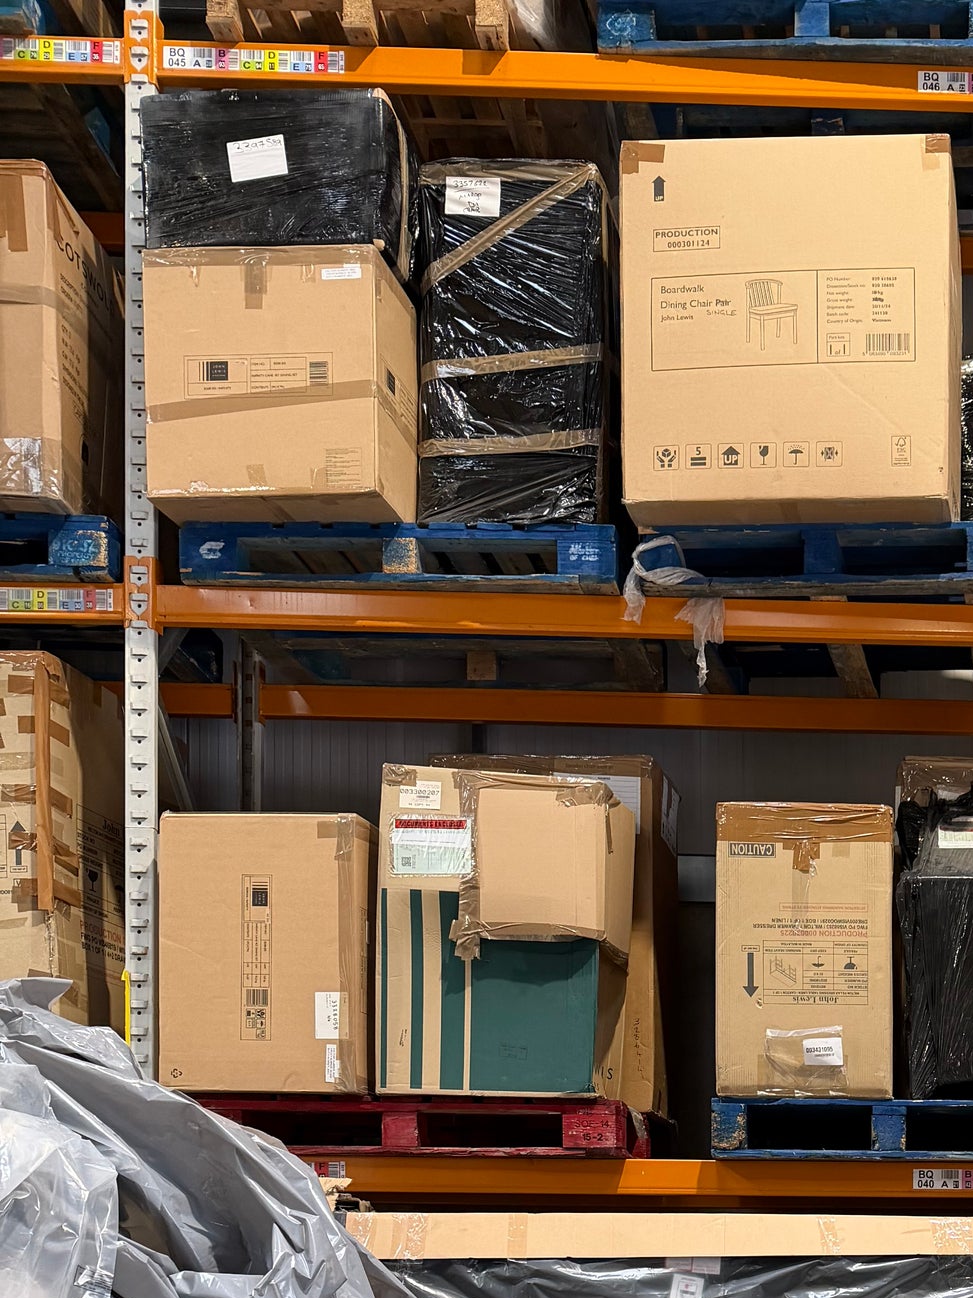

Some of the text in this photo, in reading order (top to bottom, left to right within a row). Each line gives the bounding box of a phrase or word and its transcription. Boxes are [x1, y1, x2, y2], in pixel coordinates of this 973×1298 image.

[42, 40, 50, 49] D
[93, 42, 100, 50] F
[168, 48, 186, 58] BQ
[218, 50, 226, 58] B
[268, 51, 276, 60] D
[318, 52, 325, 60] F
[168, 58, 186, 67] 045
[192, 60, 201, 68] A
[242, 61, 251, 70] C
[293, 62, 300, 71] E
[923, 72, 940, 82] BQ
[922, 82, 940, 92] 046
[655, 228, 718, 238] PRODUCTION
[668, 239, 710, 248] 000301124
[660, 284, 704, 294] Boardwalk
[660, 300, 688, 310] Dining
[690, 300, 712, 308] Chair
[660, 314, 675, 323] John
[696, 446, 701, 456] 5
[724, 454, 738, 464] UP
[731, 843, 772, 855] CAUTION
[820, 930, 868, 938] PRODUCTION
[819, 996, 840, 1004] John
[582, 1132, 604, 1141] 15-2
[918, 1170, 934, 1179] BQ
[917, 1180, 935, 1189] 040
